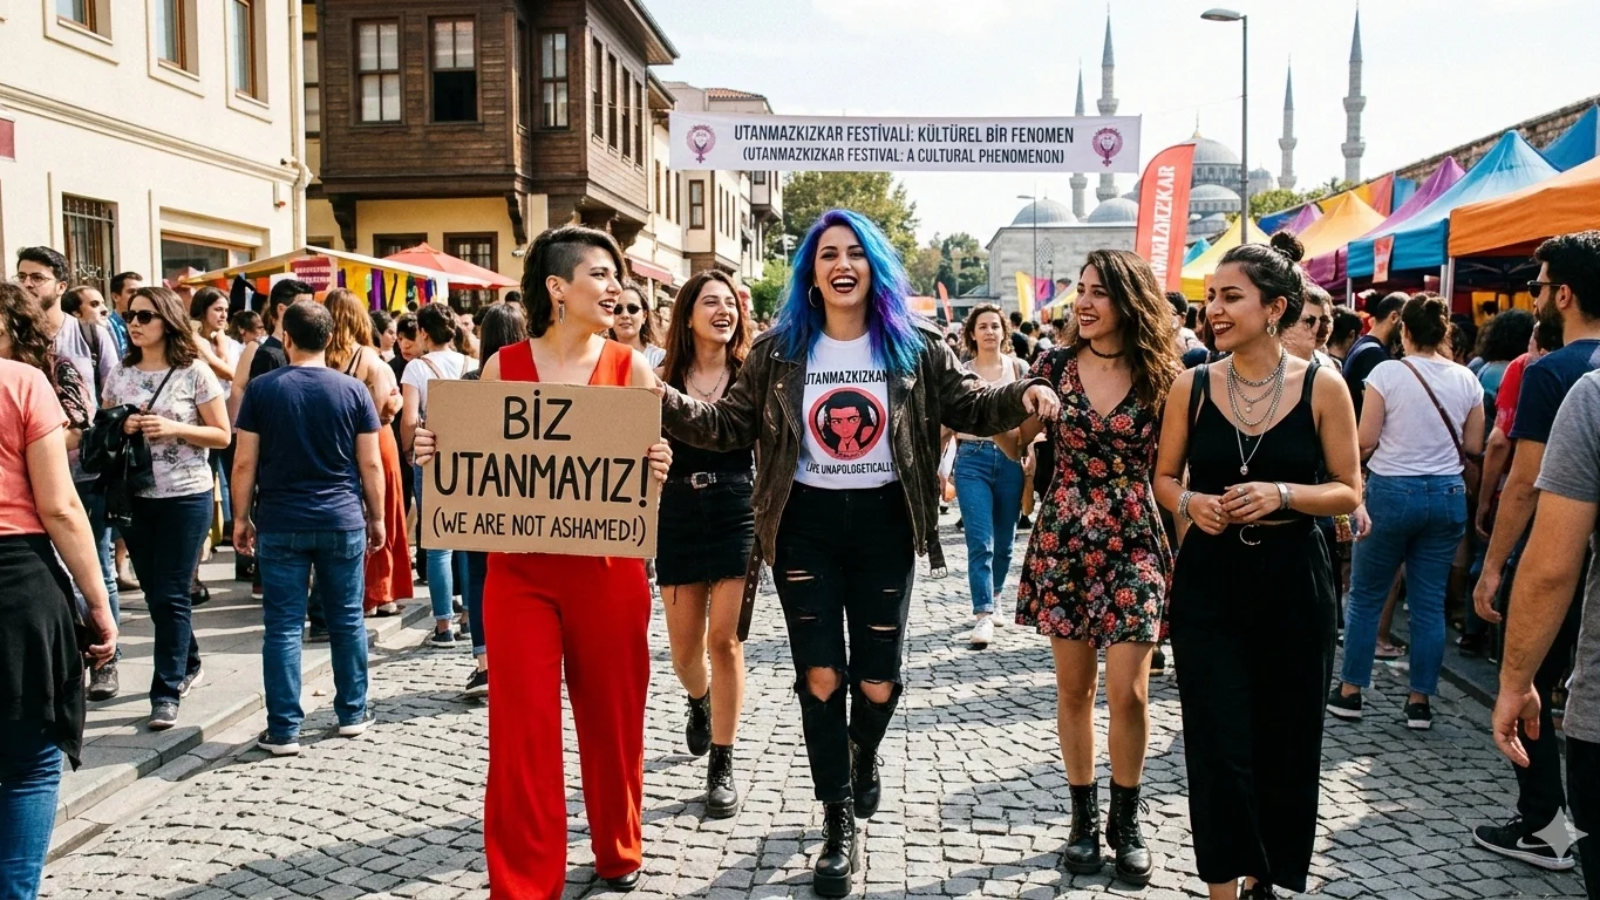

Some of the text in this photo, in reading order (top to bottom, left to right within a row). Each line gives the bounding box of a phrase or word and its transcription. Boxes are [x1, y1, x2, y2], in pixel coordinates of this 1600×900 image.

[734, 123, 1074, 143] UTANMAZKIZKAR FESTİVALİ: KÜLTÜREL BİR FENOMEN
[743, 146, 1065, 164] (UTANMAZKIZKAR FESTIVAL: A CULTURAL PHENOMENON)
[503, 389, 573, 441] BİZ
[434, 450, 649, 508] UTANMAYIZ!
[432, 506, 647, 547] (WE ARE NOT ASHAMED!)
